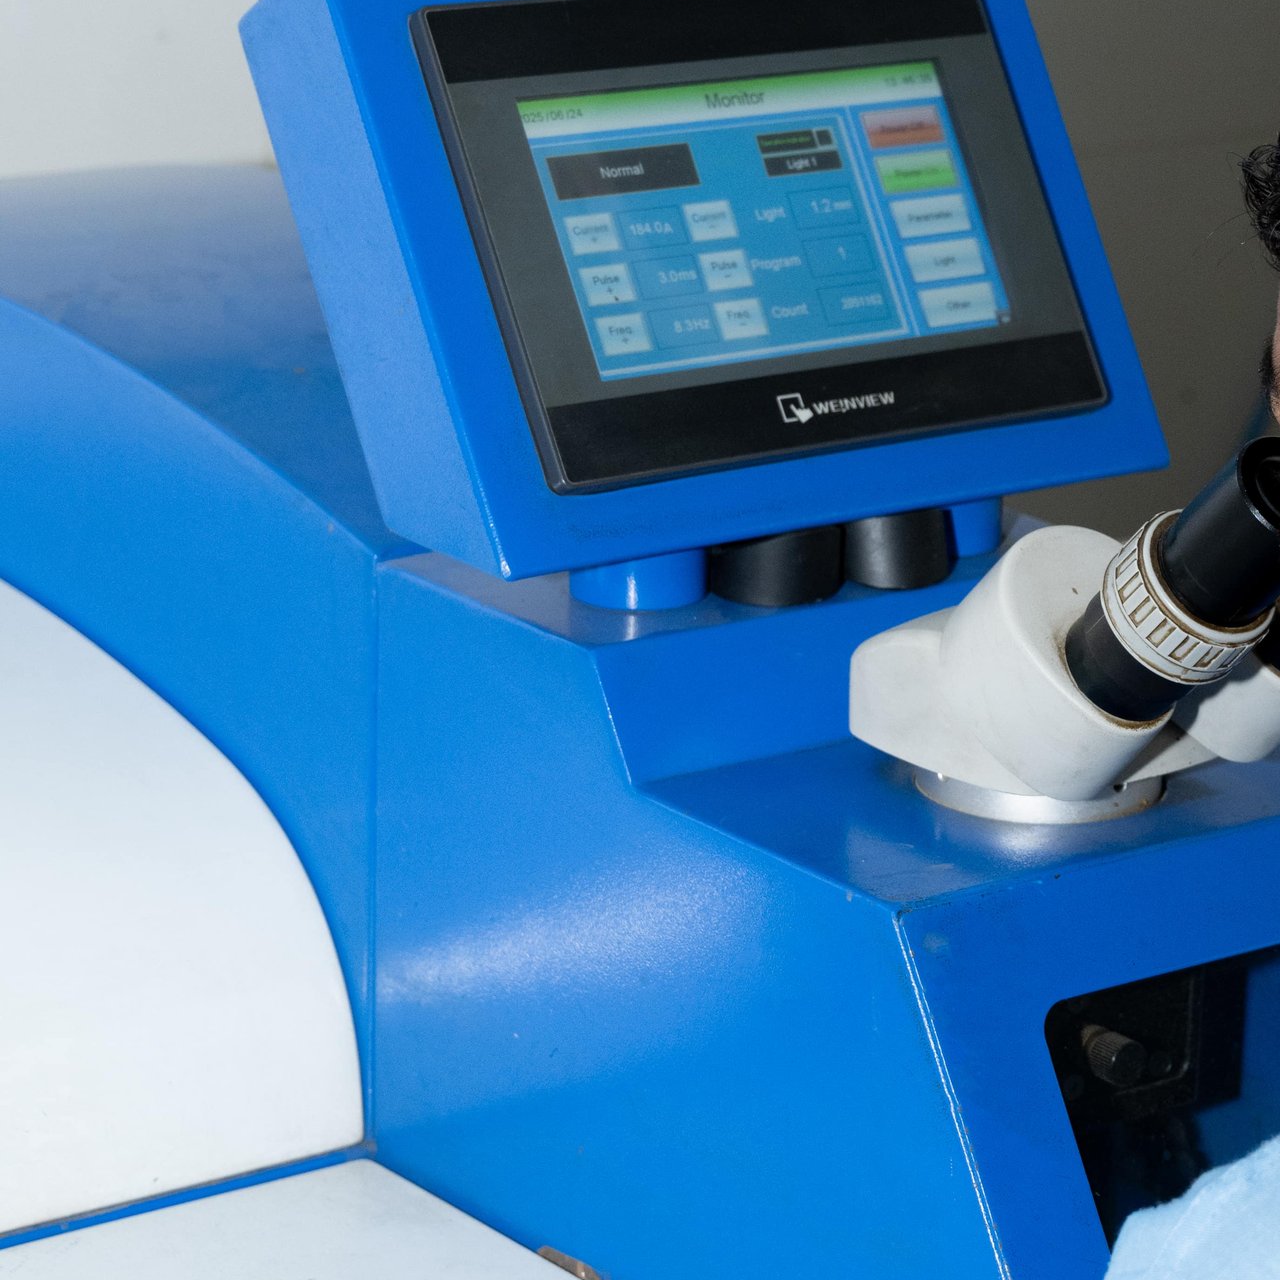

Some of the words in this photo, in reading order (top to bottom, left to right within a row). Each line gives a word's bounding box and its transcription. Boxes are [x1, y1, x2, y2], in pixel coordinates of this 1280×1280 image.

[705, 91, 764, 109] Monitor
[786, 158, 810, 170] Light
[600, 164, 644, 179] Normal
[691, 210, 727, 223] Current
[755, 206, 786, 222] Light
[573, 224, 608, 236] Current
[710, 259, 738, 272] Pulse
[752, 256, 801, 271] Program
[592, 274, 620, 287] Pulse
[771, 303, 808, 317] Count
